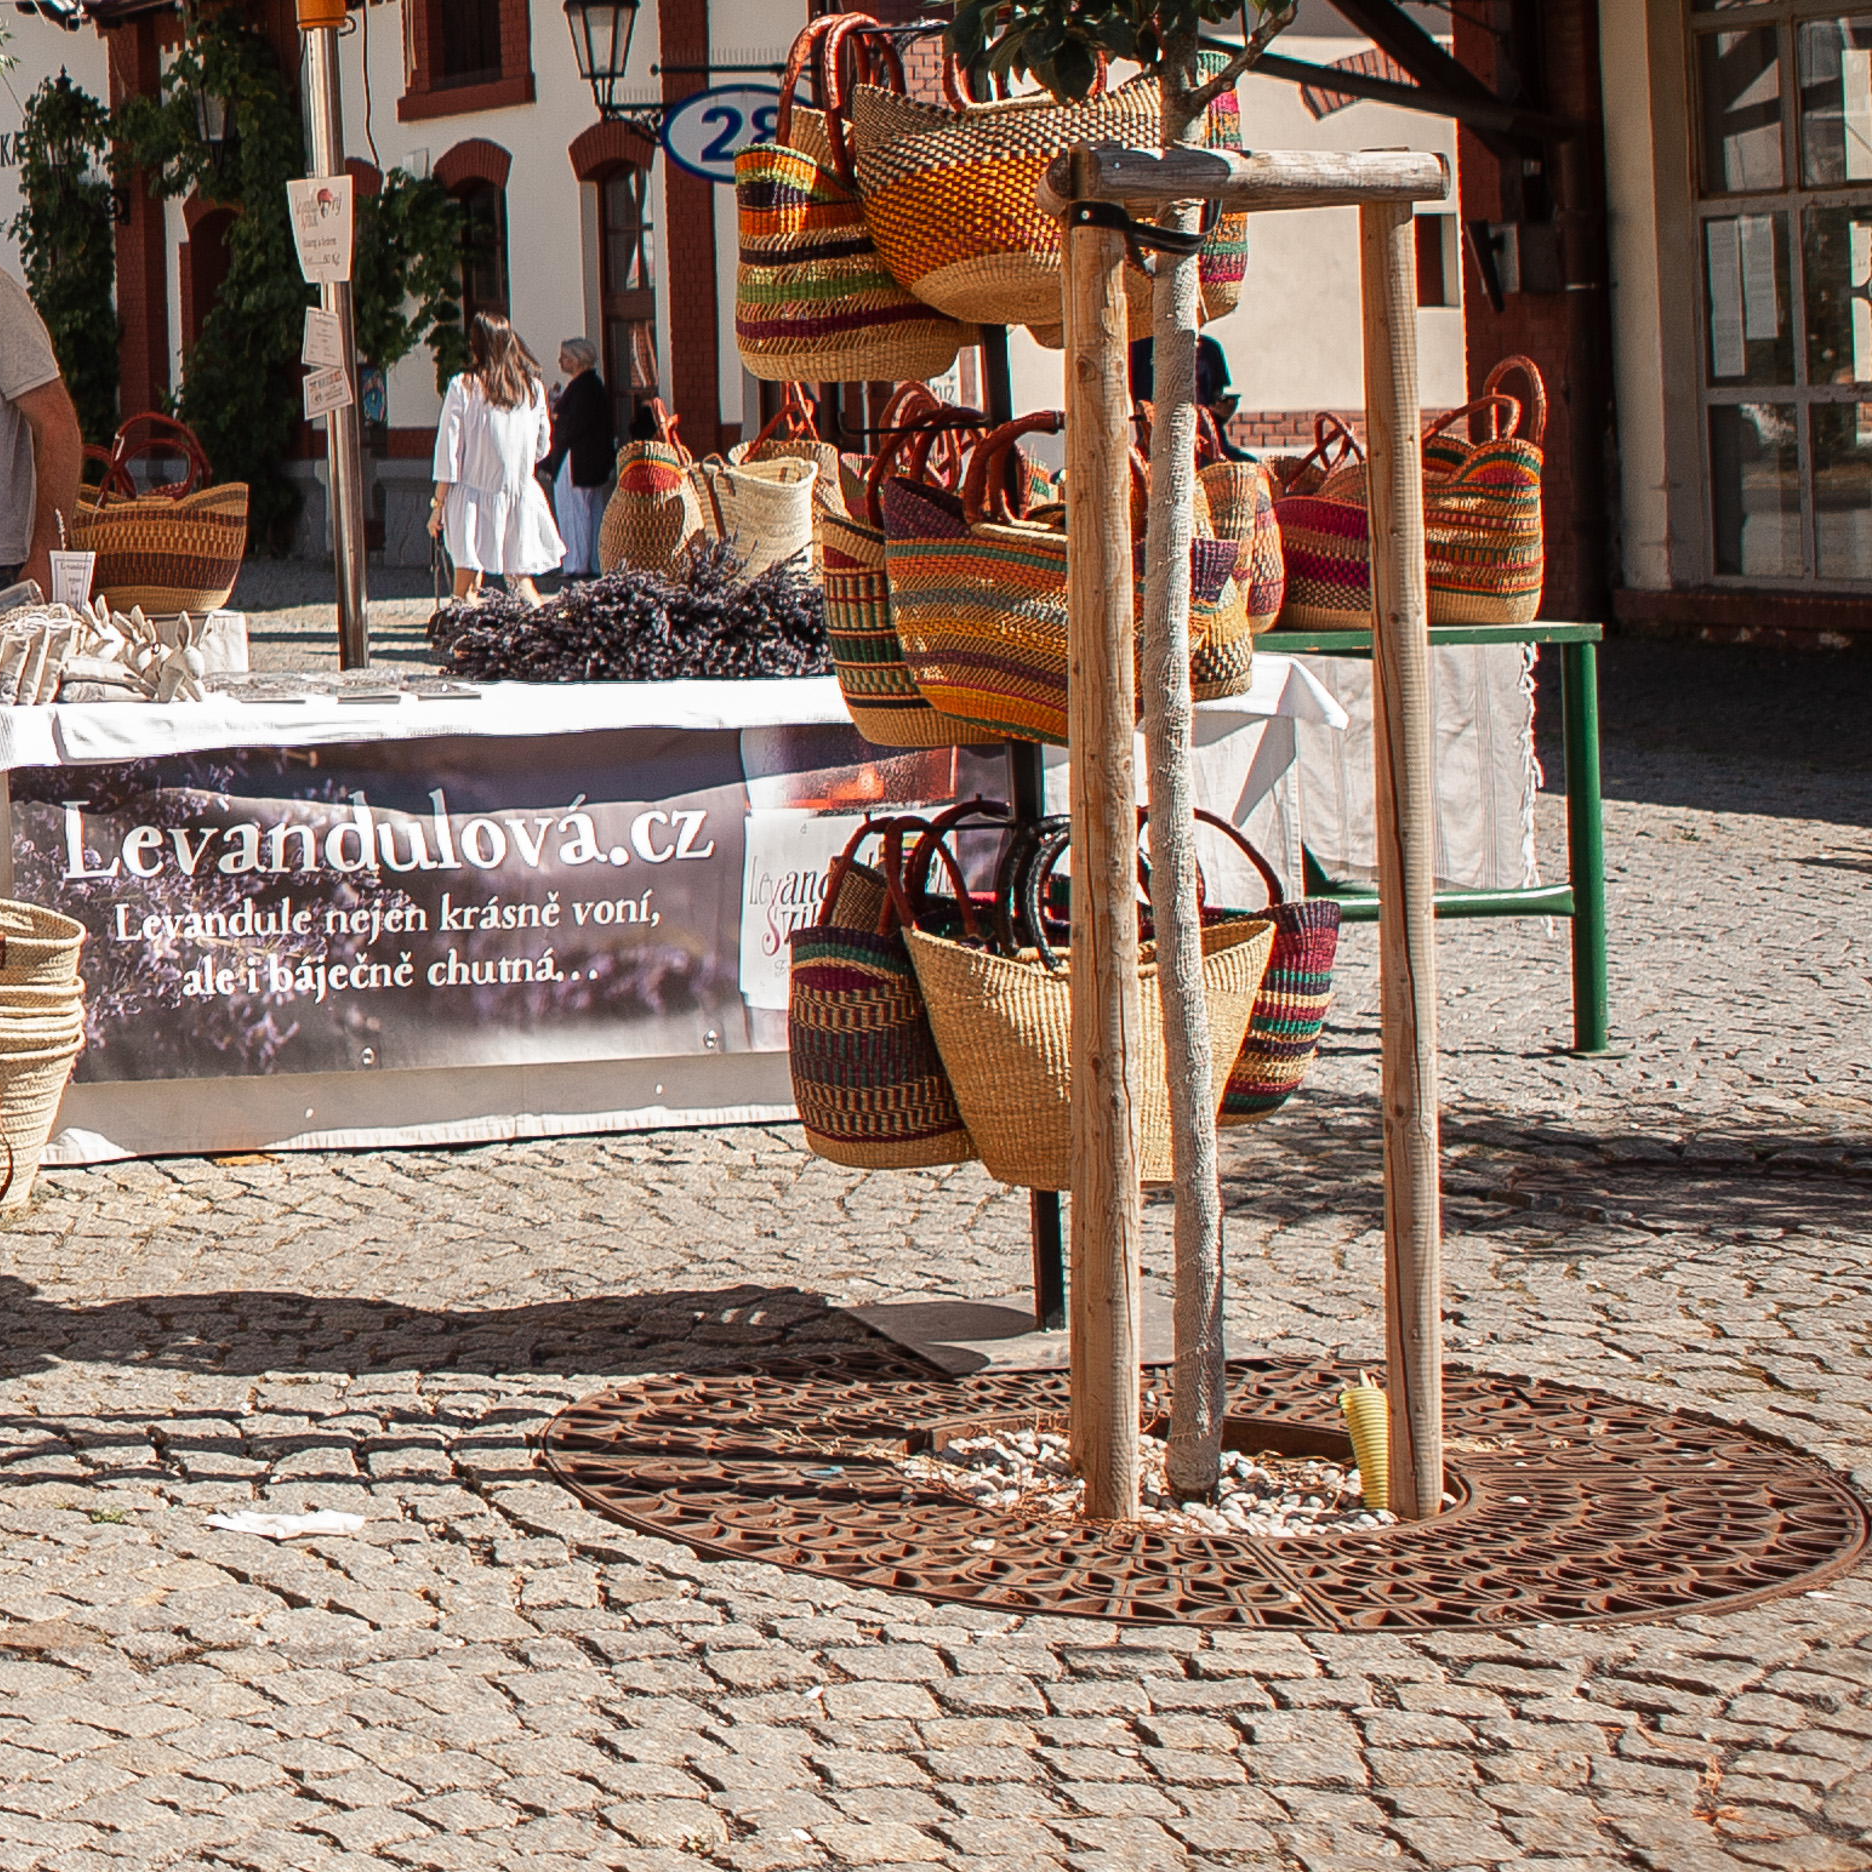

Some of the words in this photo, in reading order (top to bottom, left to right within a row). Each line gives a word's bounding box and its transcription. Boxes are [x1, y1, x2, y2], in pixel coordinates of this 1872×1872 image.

[62, 787, 715, 880] Levandulová.cz
[114, 895, 312, 942] Levandule
[325, 897, 429, 946] nejen
[439, 890, 562, 932] krásně
[572, 889, 662, 928] voní,
[182, 954, 236, 996] ale
[247, 957, 261, 995] i
[269, 950, 415, 1005] báječně
